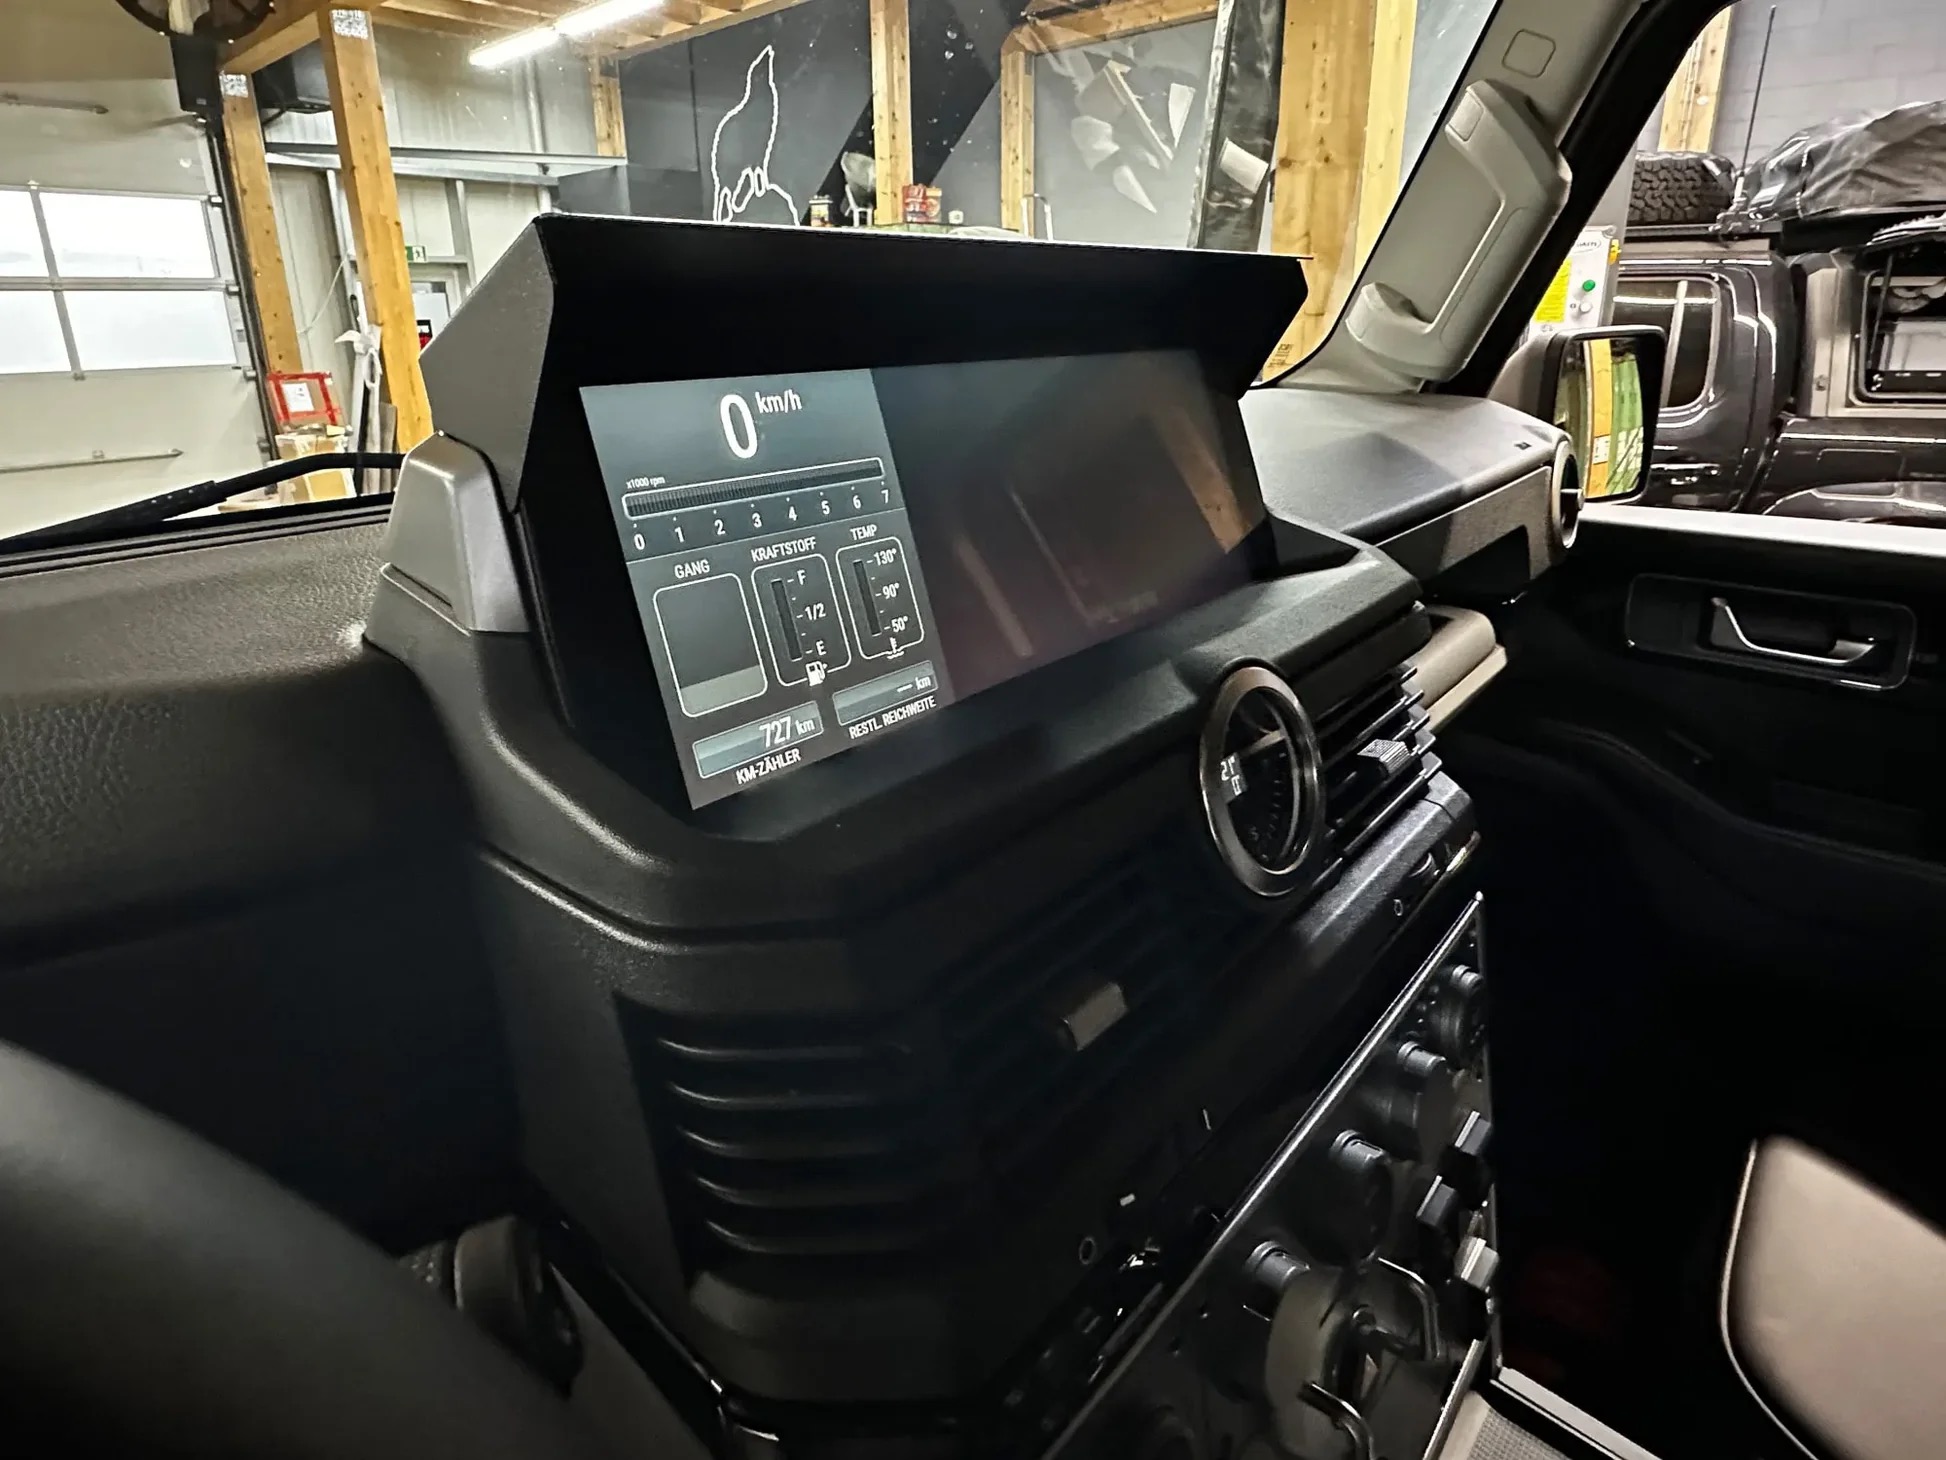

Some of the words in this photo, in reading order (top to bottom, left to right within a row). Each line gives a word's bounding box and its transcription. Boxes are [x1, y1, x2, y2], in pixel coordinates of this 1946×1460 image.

[719, 393, 758, 459] 0
[755, 389, 802, 414] km/h
[626, 477, 649, 489] x1000
[650, 476, 666, 488] rpm
[633, 533, 646, 550] 0
[674, 526, 684, 543] 1
[714, 519, 726, 535] 2
[751, 512, 763, 528] 3
[788, 506, 798, 521] 4
[821, 500, 831, 515] 5
[852, 494, 862, 509] 6
[881, 489, 889, 504] 7
[850, 524, 878, 541] TEMP
[750, 536, 817, 562] KRAFTSTOFF
[674, 560, 710, 579] GANG
[797, 569, 806, 585] F
[804, 602, 826, 621] 1/2
[815, 640, 827, 656] E
[914, 676, 932, 690] km
[881, 695, 937, 727] REICHWEITE
[758, 715, 791, 748] 727
[794, 719, 815, 735] km
[735, 747, 802, 785] KM-ZÄHLER
